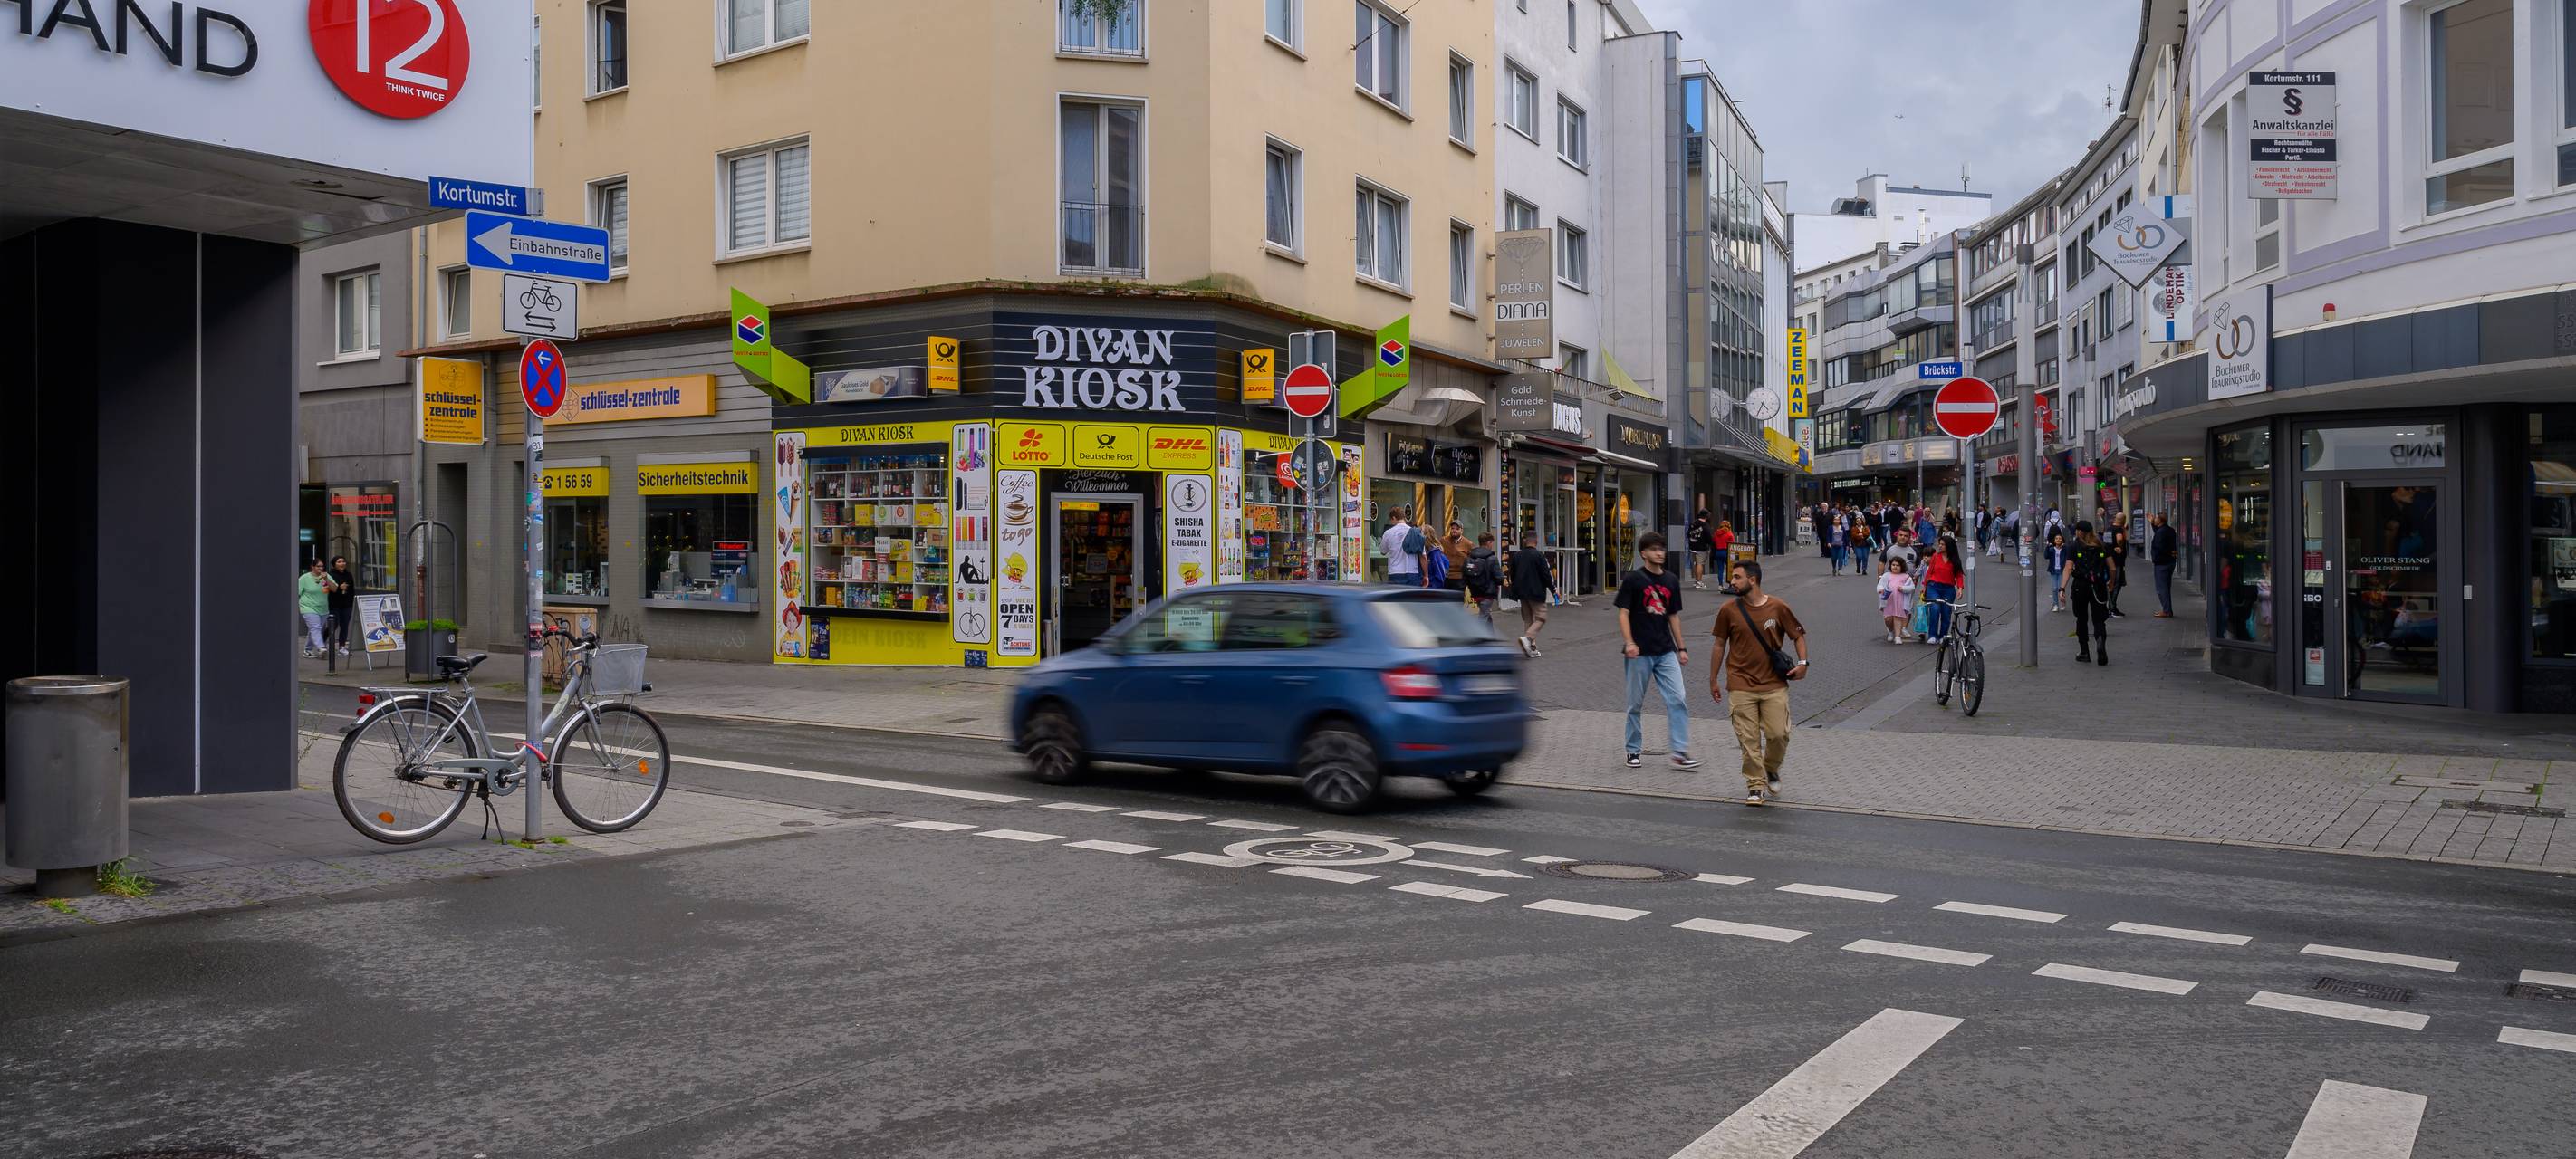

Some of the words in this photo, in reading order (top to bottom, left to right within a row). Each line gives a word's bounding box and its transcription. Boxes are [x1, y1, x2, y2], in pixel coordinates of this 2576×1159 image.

[356, 0, 448, 91] 12
[2264, 74, 2304, 83] Kortumstr.
[2306, 74, 2321, 82] 111
[385, 82, 413, 95] THINK
[416, 89, 446, 102] TWICE
[2253, 120, 2334, 131] Anwaltskanzlei
[438, 181, 518, 208] Kortumstr.
[510, 238, 601, 261] Einbahnstraße
[1500, 282, 1544, 295] PERLEN
[2175, 272, 2185, 304] OPTIK
[1497, 302, 1547, 319] DIANA
[1033, 325, 1174, 365] DIVAN
[1500, 338, 1544, 349] JUWELEN
[1791, 331, 1804, 414] ZEEMAN
[1924, 365, 1957, 376] Brückstr.
[1022, 366, 1186, 411] KIOSK
[1511, 386, 1535, 396] Gold-
[425, 391, 482, 405] schlüssel-
[581, 386, 680, 410] schlüssel-zentrale
[1500, 397, 1547, 407] Schmiede-
[429, 407, 477, 418] zentrale
[1511, 407, 1536, 417] Kunst
[841, 428, 877, 442] DIVAN
[879, 426, 915, 440] KIOSK
[532, 442, 541, 451] 31
[1150, 438, 1210, 450] DHL
[1269, 435, 1293, 450] DIVAN
[1013, 451, 1049, 461] LOTTO
[1117, 453, 1133, 461] Post
[557, 475, 562, 489] 1
[565, 474, 578, 489] 56
[580, 474, 592, 488] 59
[639, 469, 749, 488] Sicherheitstechnik
[1000, 474, 1034, 494] Coffee
[1064, 478, 1129, 493] Willkommen
[1175, 517, 1204, 527] SHISHA
[1002, 529, 1016, 540] to
[1017, 528, 1033, 546] go
[1177, 529, 1202, 537] TABAK
[1000, 603, 1034, 614] OPEN
[1000, 615, 1013, 628] 7
[1014, 615, 1034, 623] DAYS
[875, 629, 928, 649] KIOSK
